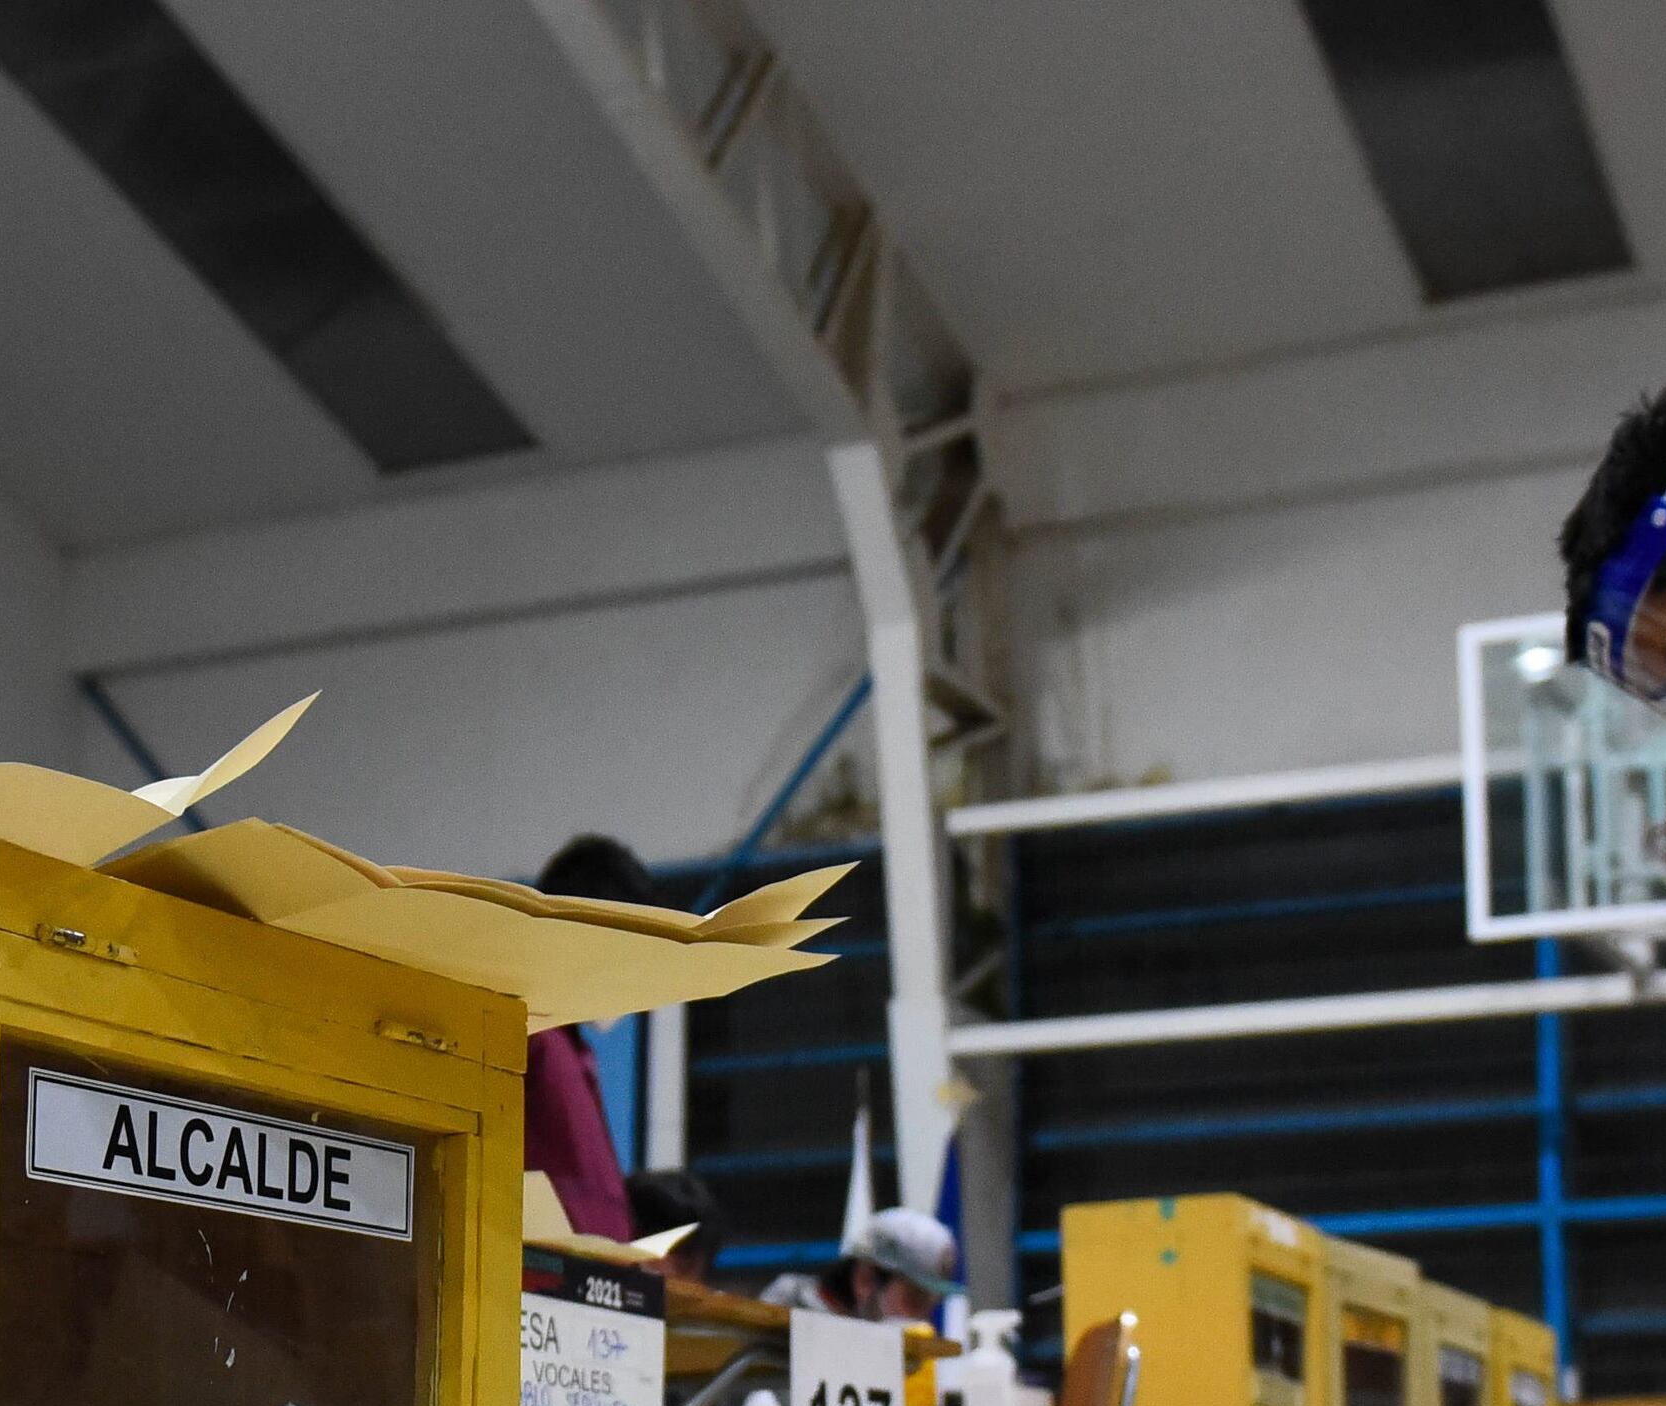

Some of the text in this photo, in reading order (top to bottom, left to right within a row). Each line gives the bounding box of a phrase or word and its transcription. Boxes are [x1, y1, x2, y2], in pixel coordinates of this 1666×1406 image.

[103, 1104, 351, 1212] ALCALDE
[585, 1275, 623, 1308] 2021
[520, 1310, 629, 1359] ESA 137
[532, 1360, 612, 1395] VOCALES
